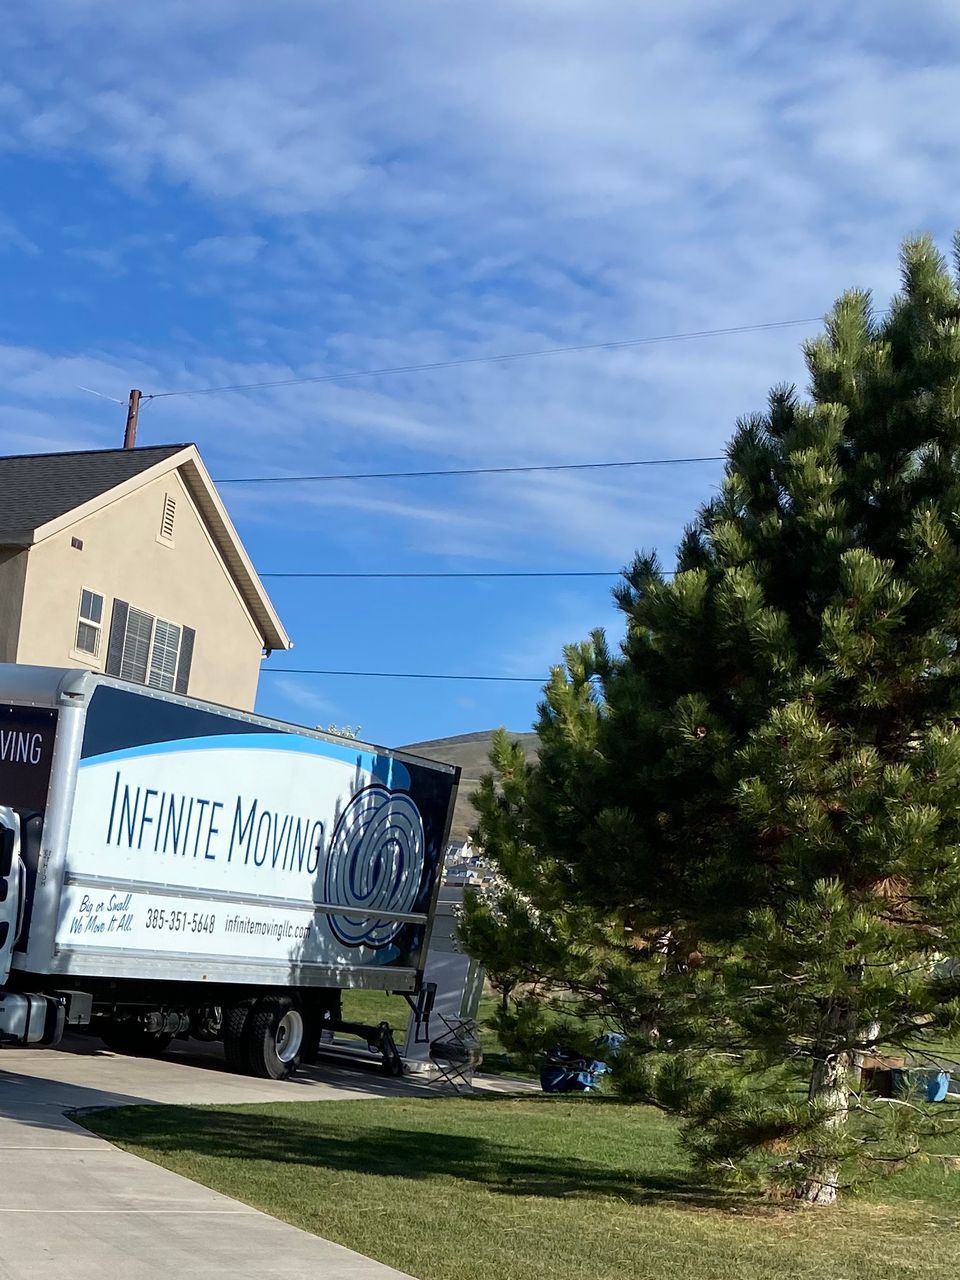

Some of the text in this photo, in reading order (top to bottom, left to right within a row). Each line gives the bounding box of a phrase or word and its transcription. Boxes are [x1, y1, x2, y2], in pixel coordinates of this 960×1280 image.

[106, 771, 324, 874] INFINITE MOVING
[79, 893, 133, 918] Big or Small
[70, 915, 84, 934] We
[84, 915, 106, 933] Move
[107, 914, 117, 932] It
[145, 908, 216, 934] 385-351-5648
[225, 914, 311, 942] infinitemovingllc.com
